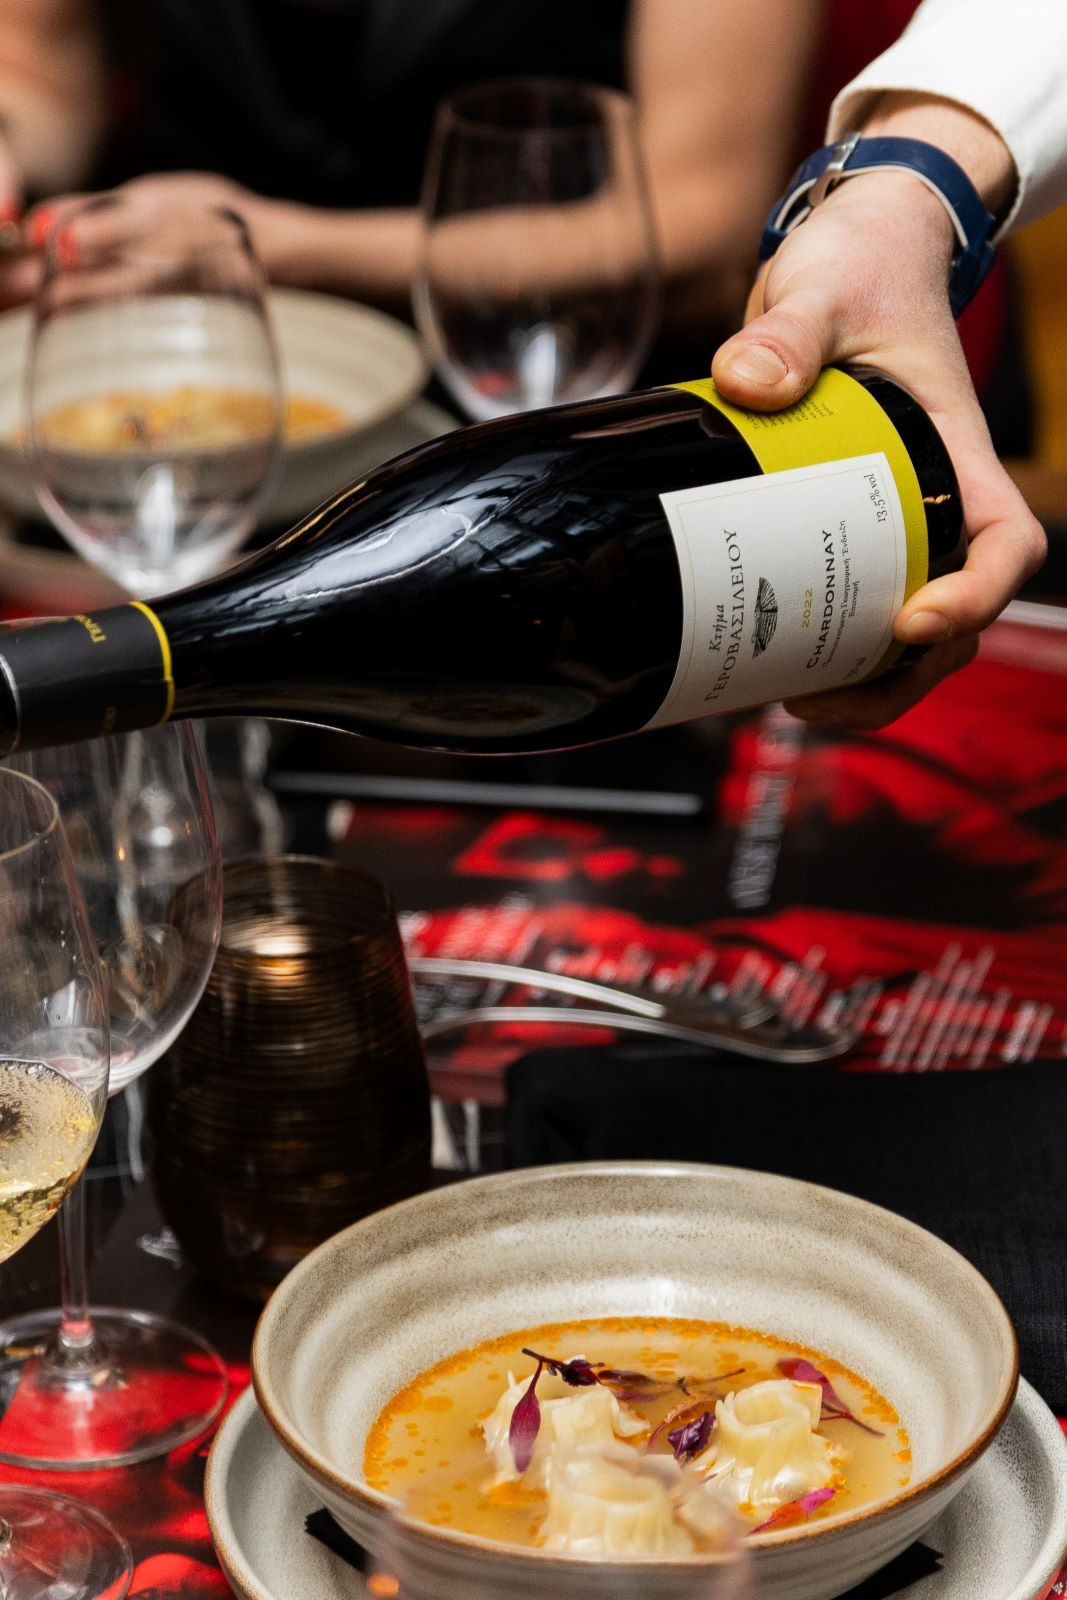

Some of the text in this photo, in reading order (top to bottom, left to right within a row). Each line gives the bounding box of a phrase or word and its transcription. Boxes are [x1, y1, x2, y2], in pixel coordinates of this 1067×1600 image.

[863, 473, 878, 489] vol
[704, 528, 745, 701] ΓΕΡΟΒΑΣΙΛΕΙΟΥ
[801, 587, 814, 629] 2022
[806, 529, 835, 669] CHARDONNAY
[709, 603, 727, 651] Κτήμα
